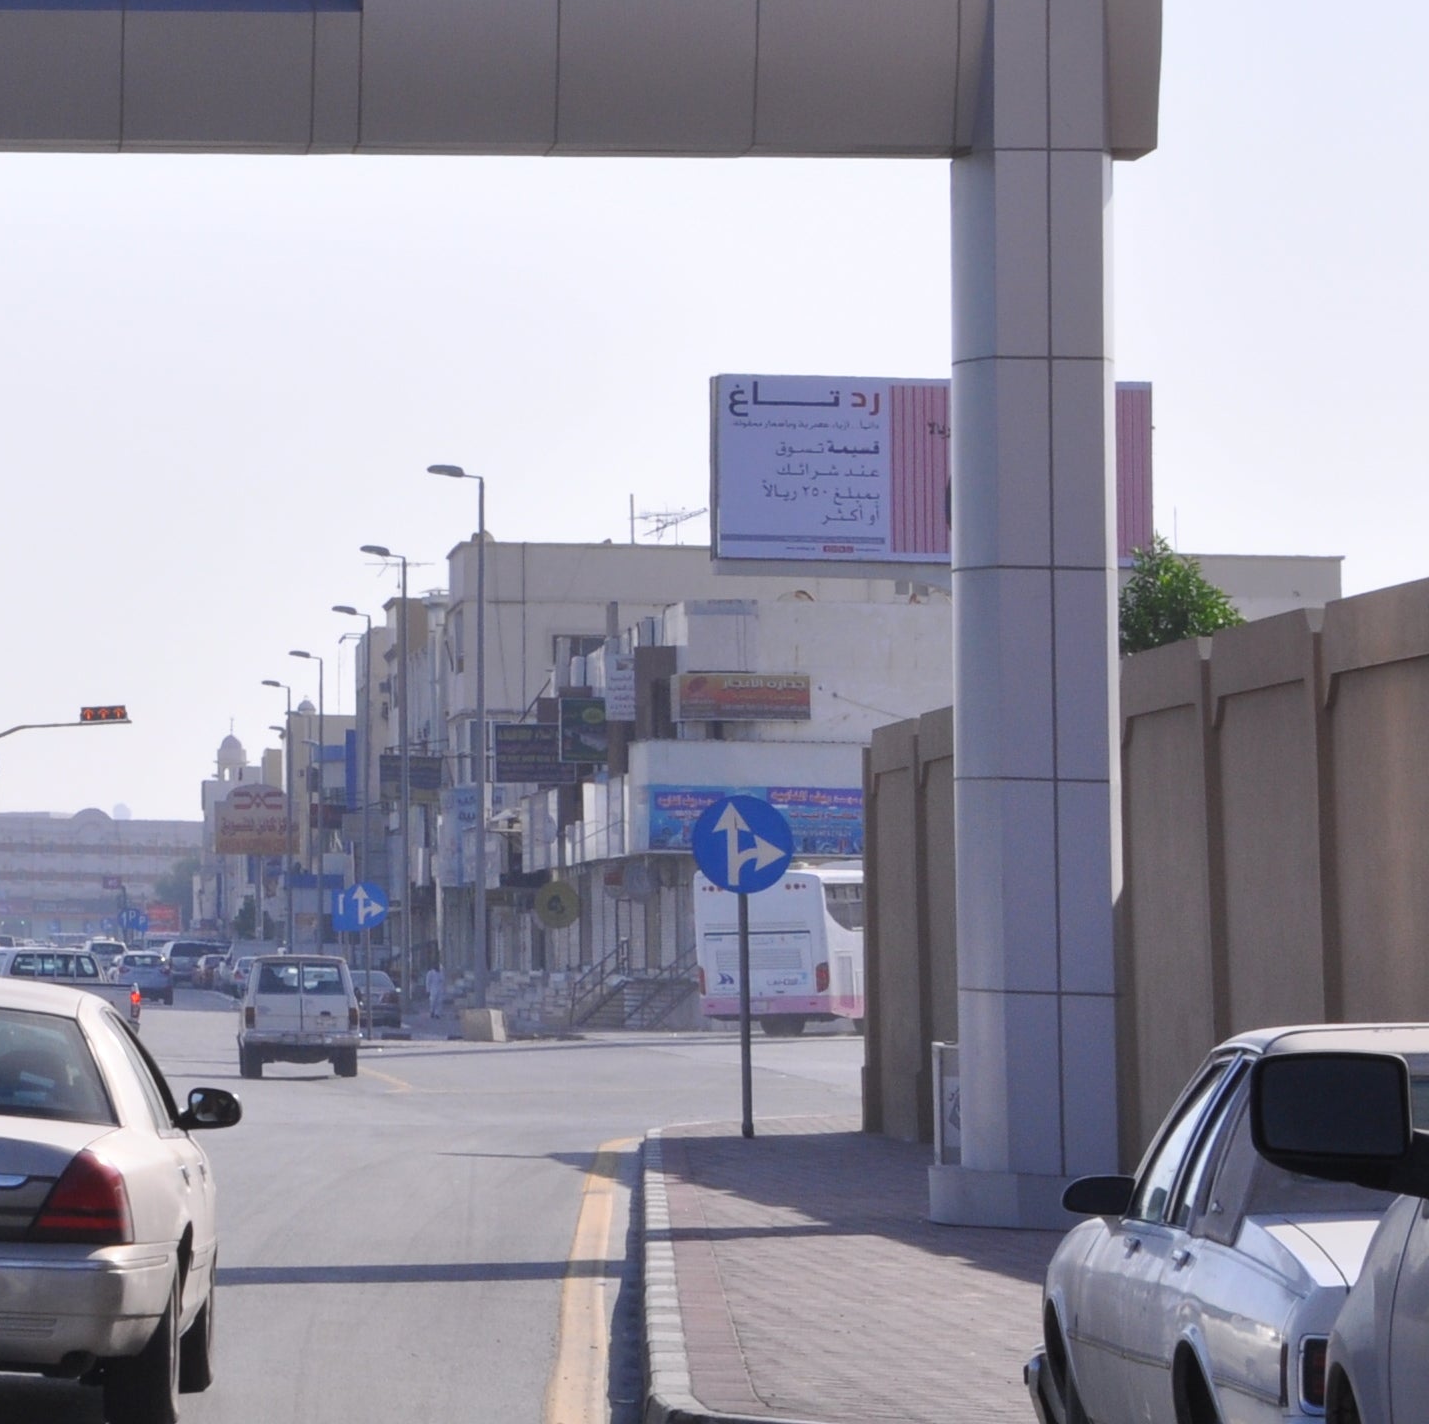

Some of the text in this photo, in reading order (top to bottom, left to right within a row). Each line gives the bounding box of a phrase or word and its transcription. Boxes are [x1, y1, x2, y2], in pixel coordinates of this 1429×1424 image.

[851, 391, 880, 416] رد
[775, 440, 880, 458] قسيمة تسوق
[844, 463, 880, 478] عند
[833, 486, 880, 506] بمبلغ
[821, 504, 864, 525] أكثر
